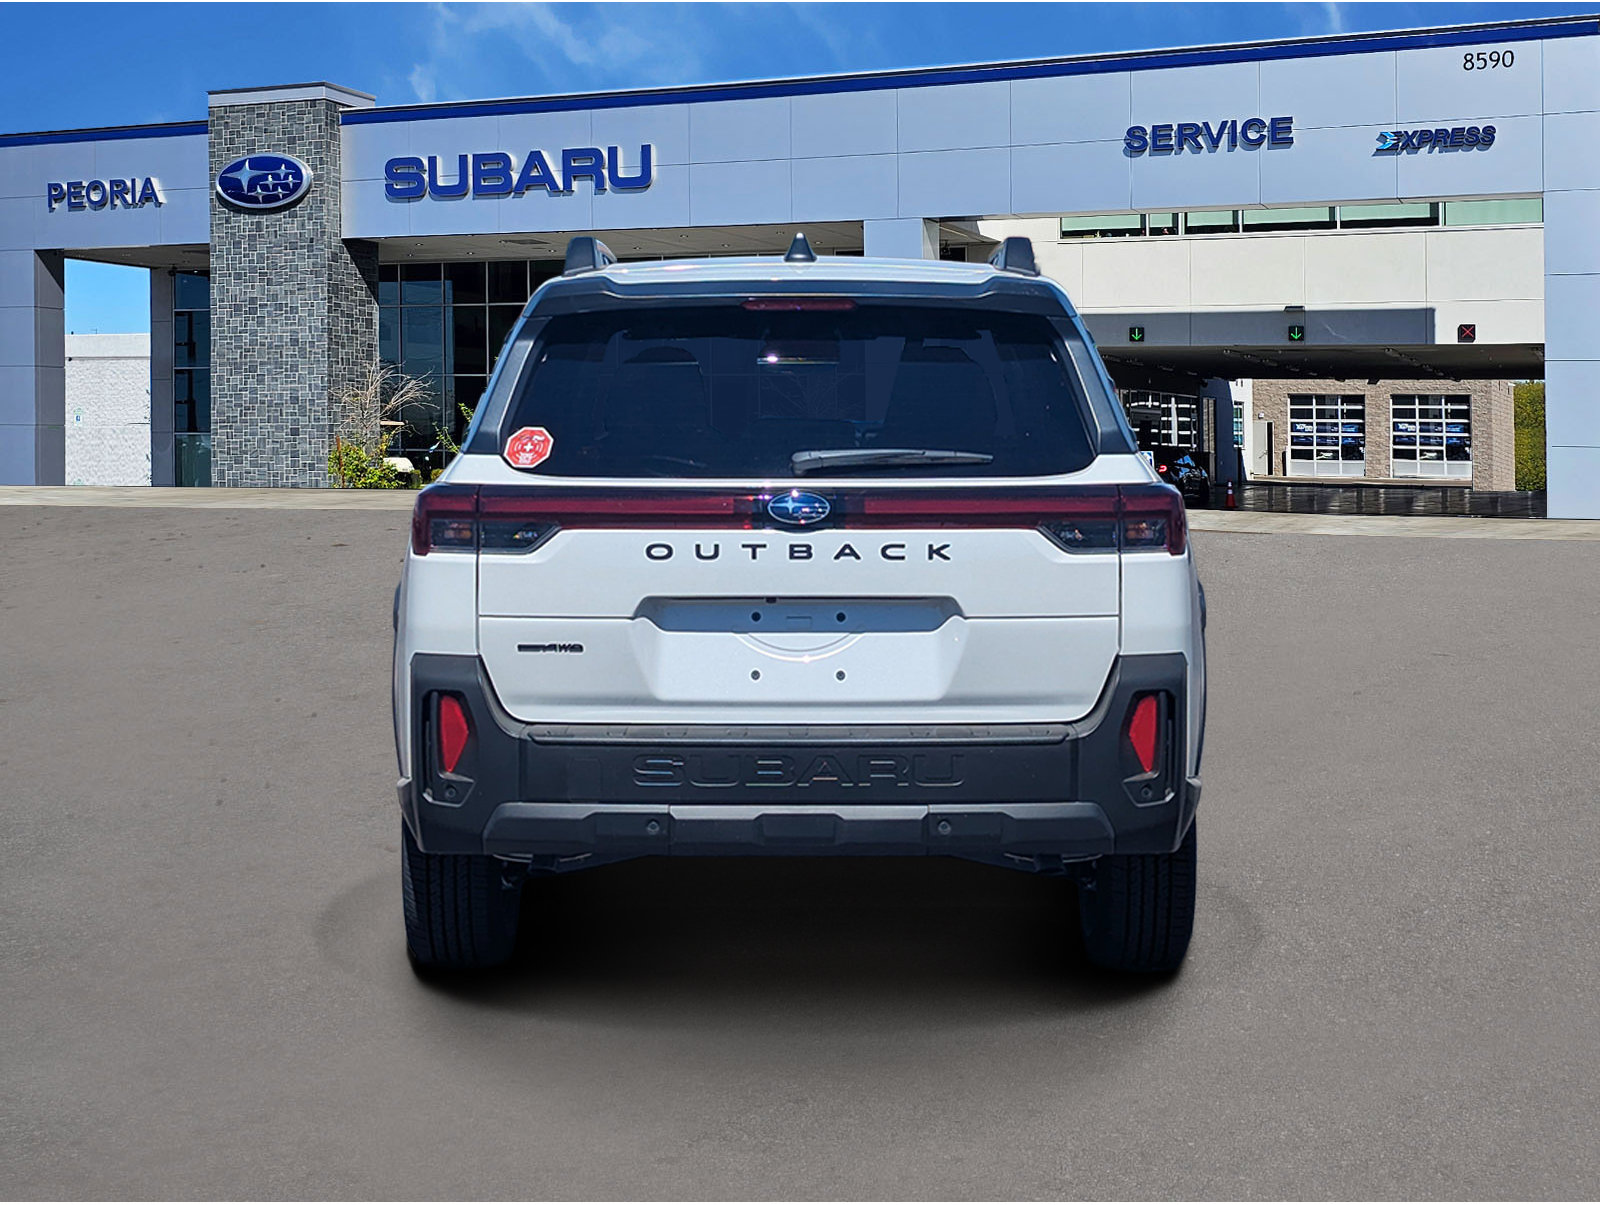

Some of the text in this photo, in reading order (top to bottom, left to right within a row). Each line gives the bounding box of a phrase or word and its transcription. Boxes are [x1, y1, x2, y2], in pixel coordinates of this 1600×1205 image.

[1463, 50, 1515, 71] 8590
[1124, 116, 1294, 154] SERVICE
[1375, 126, 1496, 153] EXPRESS
[385, 144, 653, 202] SUBARU
[48, 177, 163, 211] PEORIA
[645, 543, 952, 561] OUTBACK
[632, 753, 965, 787] SUBARU
